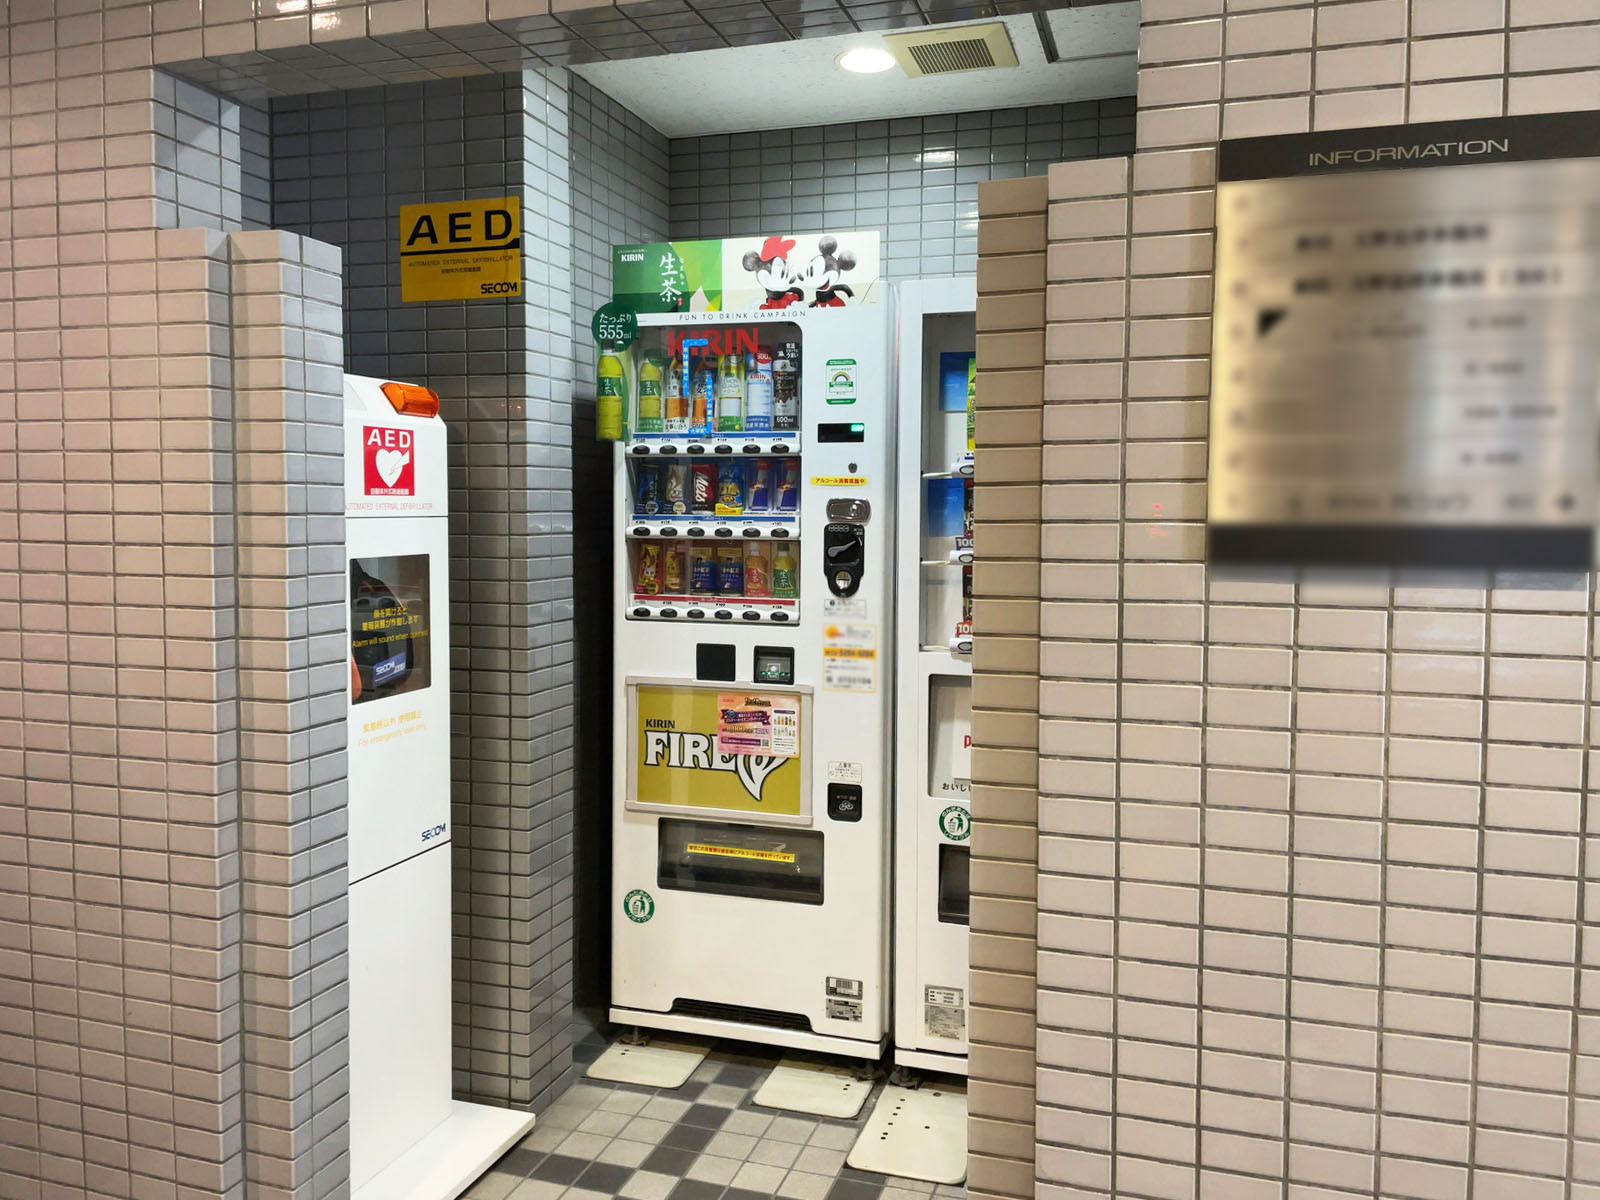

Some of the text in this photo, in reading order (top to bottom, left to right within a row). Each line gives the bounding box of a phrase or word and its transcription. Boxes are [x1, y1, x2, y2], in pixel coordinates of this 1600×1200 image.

[1309, 139, 1509, 166] INFORMATION
[406, 209, 513, 246] AED
[621, 253, 644, 262] KIRIN
[659, 252, 683, 303] 生茶
[480, 282, 518, 295] SECOM
[599, 313, 633, 324] たっぷり
[679, 309, 807, 321] FUN TO DRINK CAMPAIGN
[667, 327, 759, 357] KIRIN
[367, 428, 411, 448] AED
[645, 719, 675, 729] KIRIN
[644, 730, 739, 773] FIRE
[422, 823, 447, 842] SECOM
